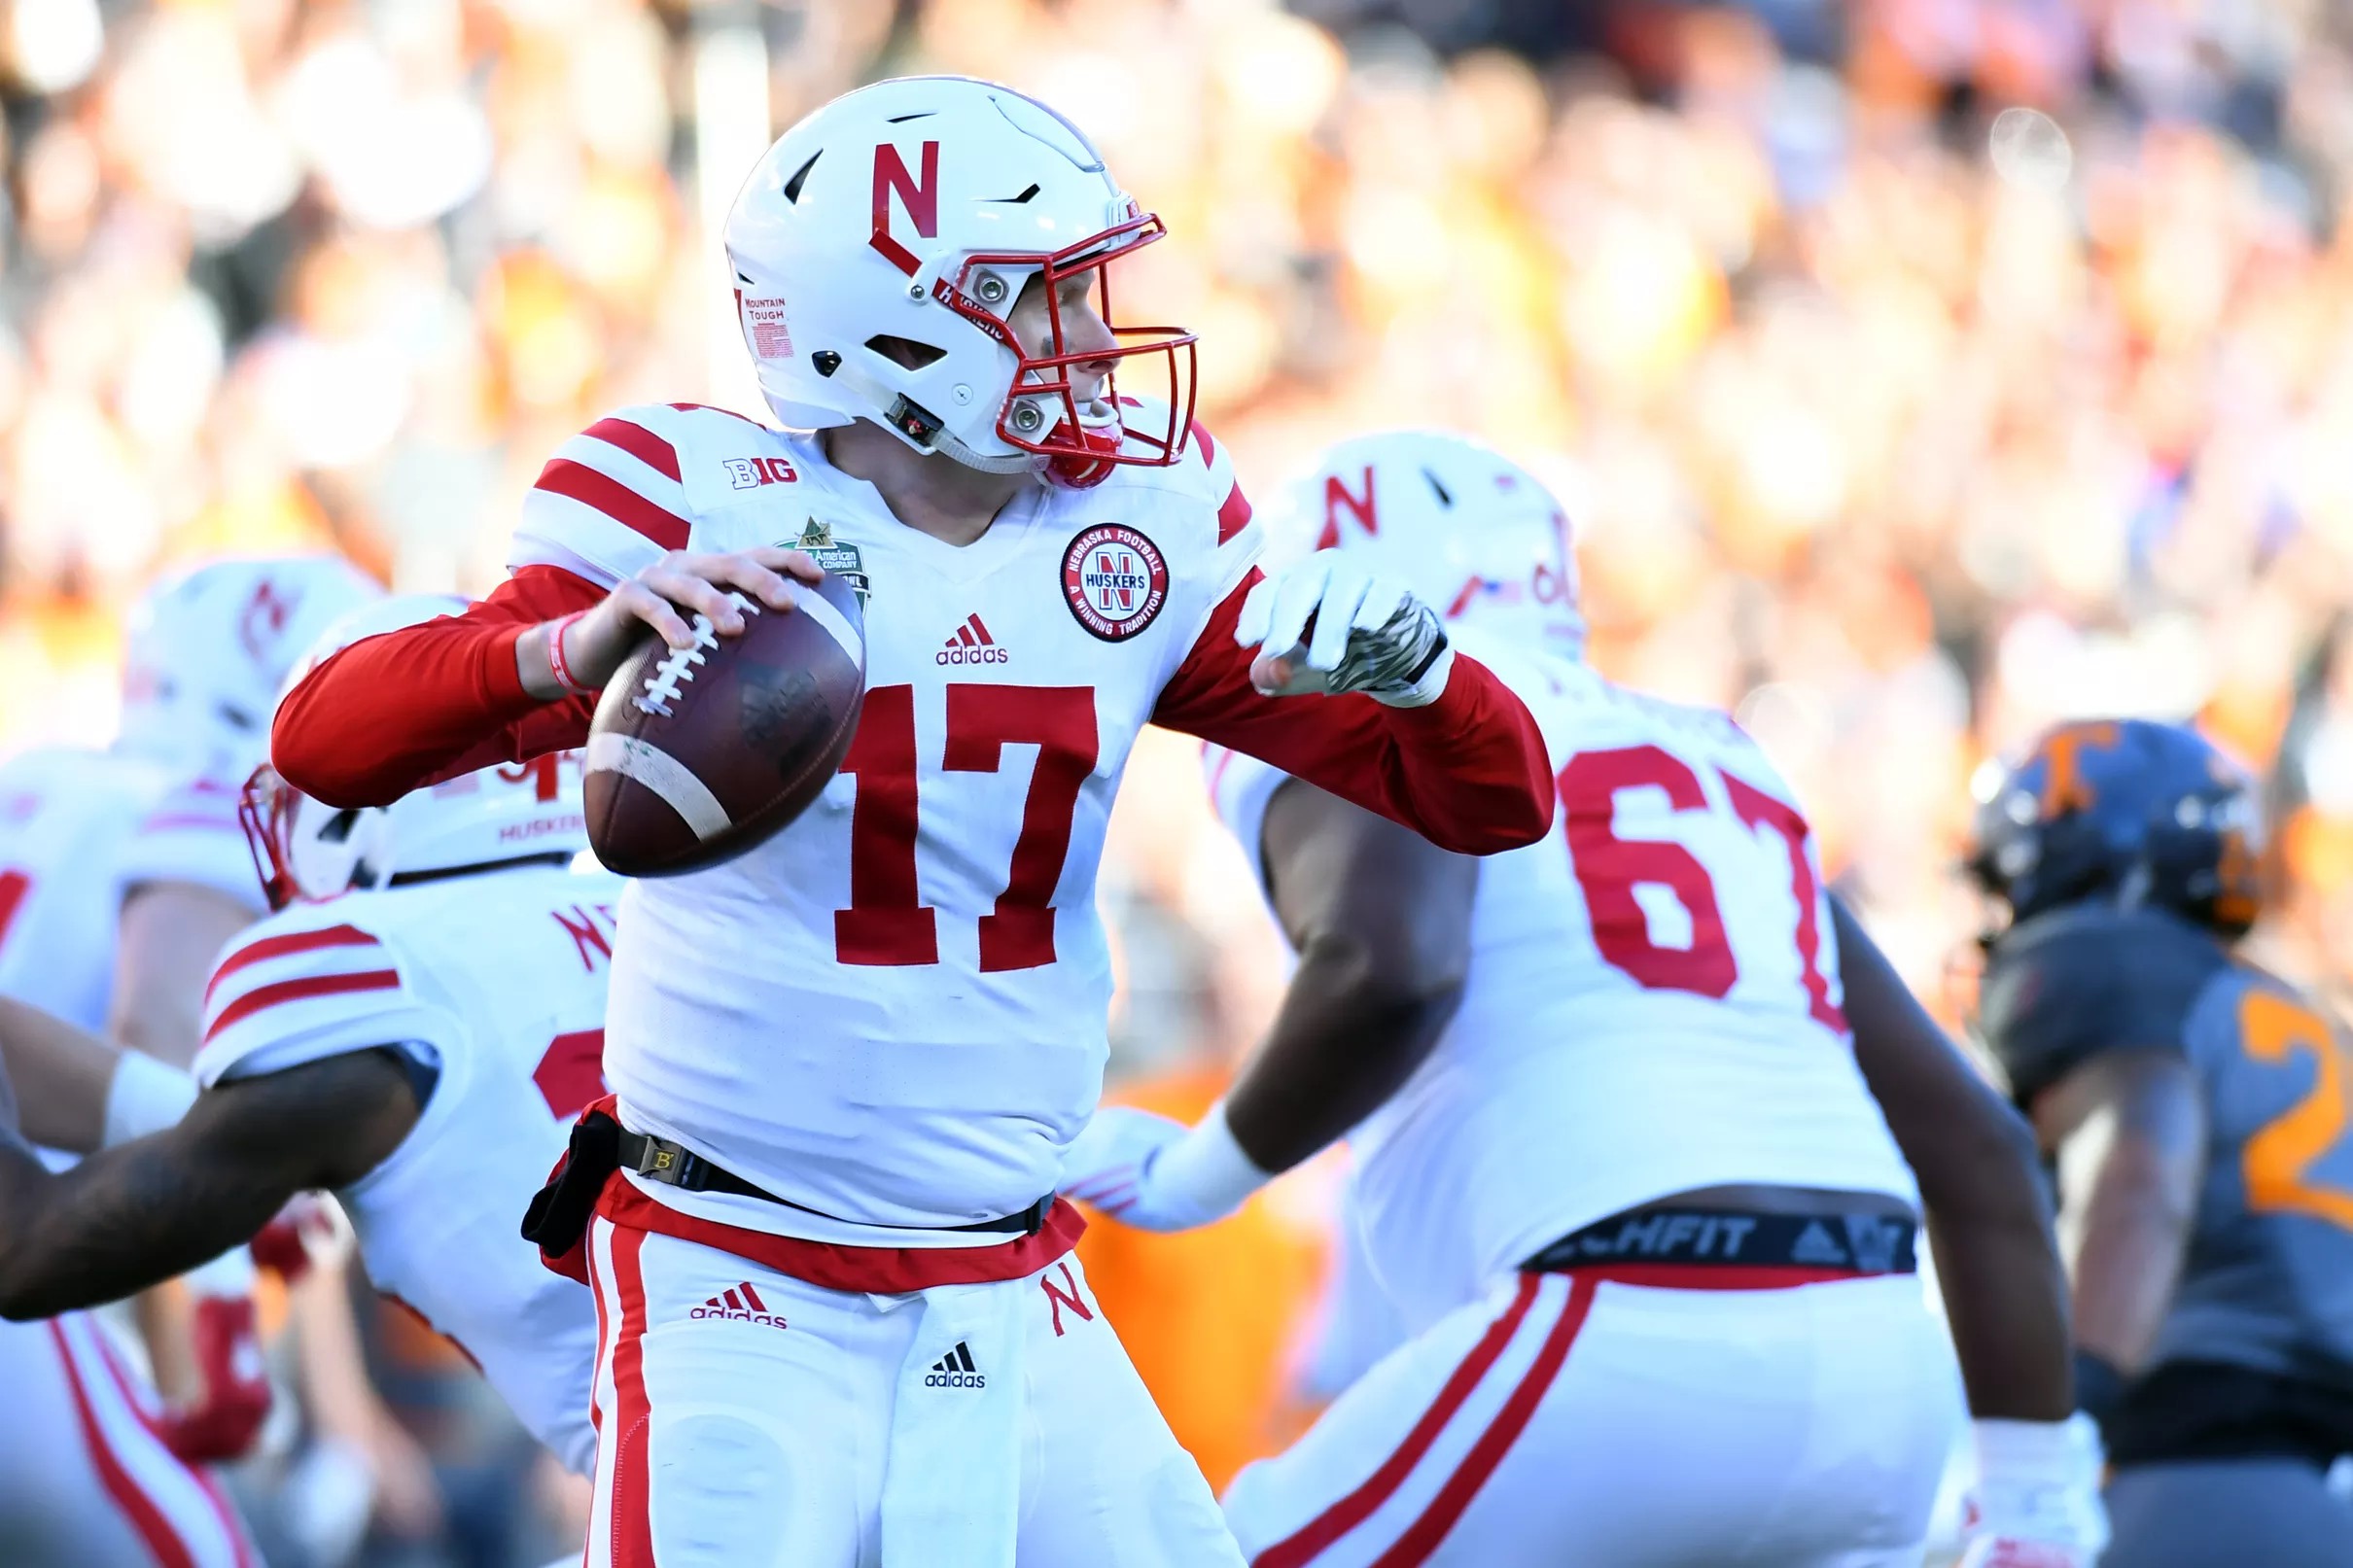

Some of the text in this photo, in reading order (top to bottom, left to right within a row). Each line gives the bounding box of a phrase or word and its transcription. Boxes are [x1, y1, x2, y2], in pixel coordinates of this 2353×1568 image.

[871, 141, 939, 238] N
[745, 297, 786, 308] MOUNTAIN
[749, 310, 785, 321] TOUGH
[1317, 466, 1379, 551] N
[816, 549, 857, 561] American
[1069, 529, 1162, 575] NEBRASKA FOOTBALL
[1086, 574, 1145, 589] HUSKERS
[1070, 585, 1162, 635] A WINNING TRADITION
[936, 645, 1008, 666] adidas
[834, 683, 1100, 973] 17
[1558, 745, 1853, 1035] 67
[1040, 1262, 1094, 1337] N
[690, 1307, 788, 1330] adidas
[925, 1371, 986, 1389] adidas
